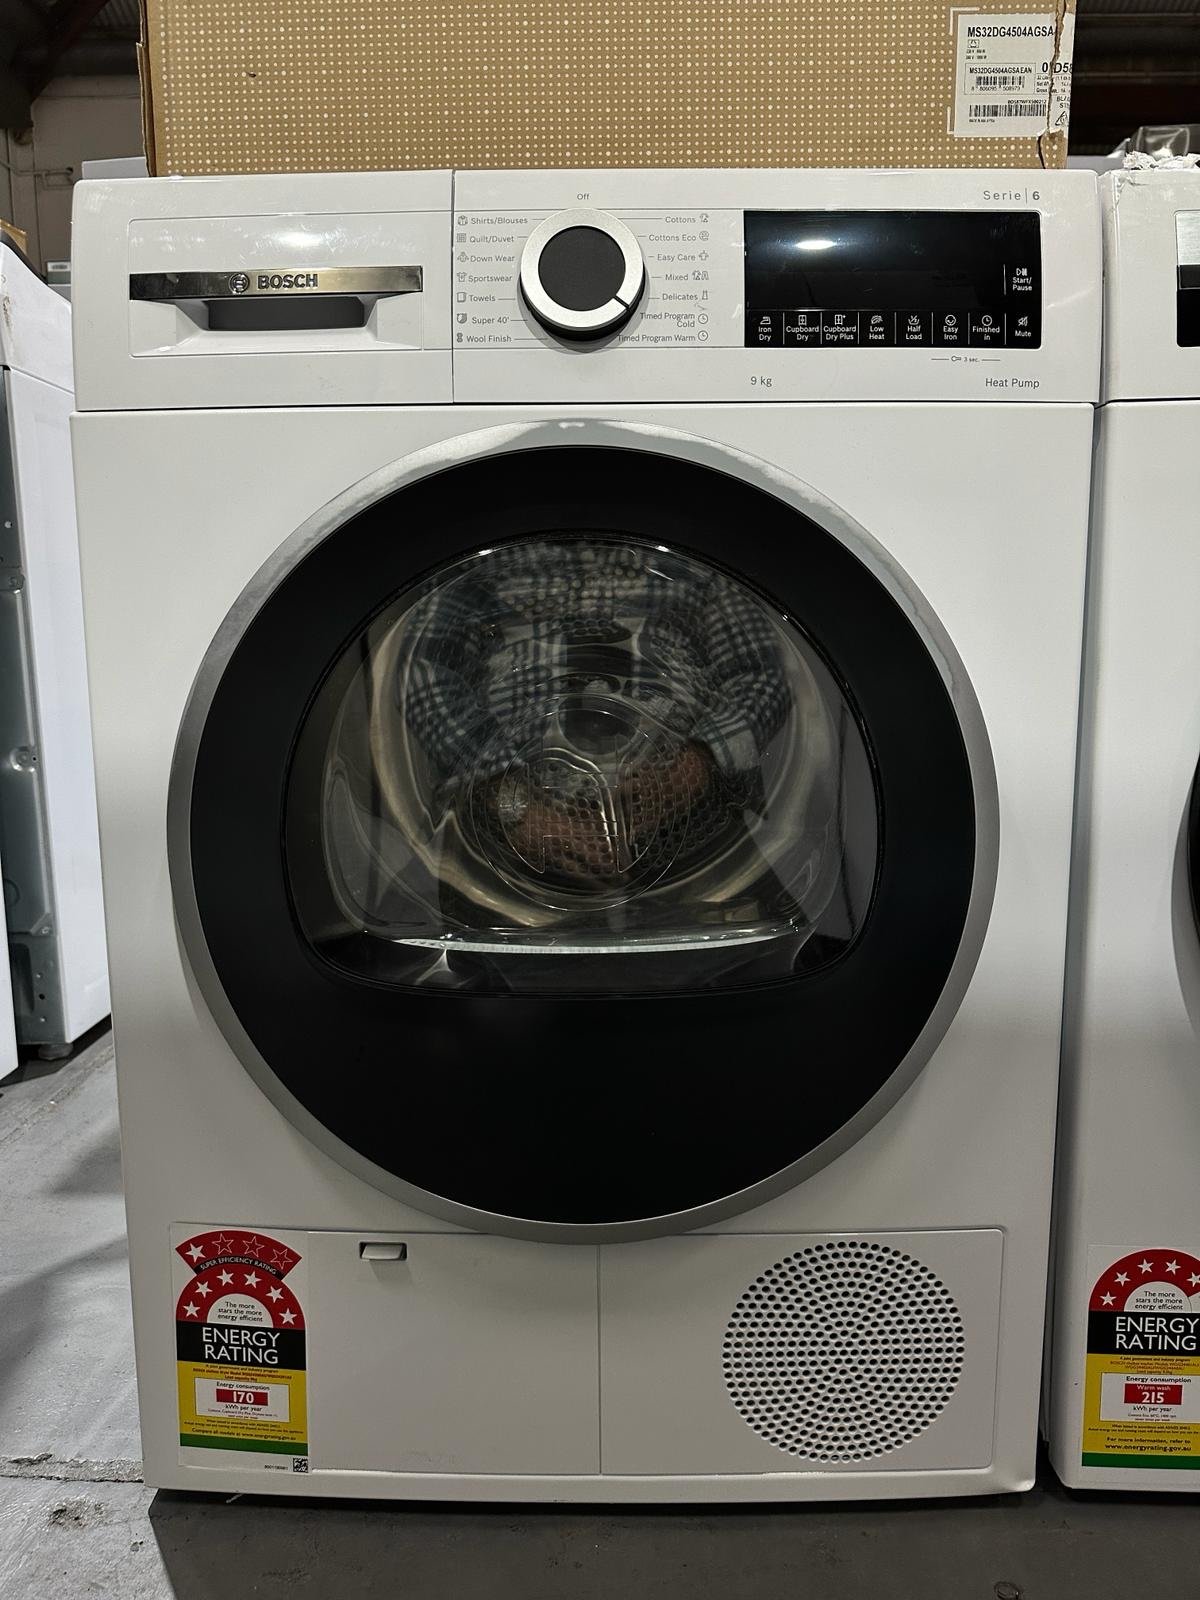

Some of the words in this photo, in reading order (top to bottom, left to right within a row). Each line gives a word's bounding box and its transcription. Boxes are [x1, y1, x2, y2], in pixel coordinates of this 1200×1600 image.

[968, 26, 1054, 37] MS32DG4504AGSA
[983, 190, 1021, 200] Serie
[1032, 191, 1040, 200] 6
[470, 215, 528, 225] Shirts/Blouses
[665, 215, 696, 224] Cottons
[469, 234, 515, 244] Quilt/Duvet
[648, 233, 680, 242] Cottons
[682, 233, 697, 242] Eco
[470, 254, 492, 263] Down
[494, 254, 515, 263] Wear
[657, 253, 675, 263] Easy
[677, 253, 696, 262] Care
[257, 273, 319, 290] BOSCH
[468, 273, 513, 283] Sportswear
[665, 273, 689, 282] Mixed
[1012, 276, 1032, 285] Start/
[1012, 284, 1033, 292] Pause
[468, 293, 496, 302] Towels
[662, 292, 699, 301] Delicates
[471, 316, 494, 326] Super
[640, 312, 662, 321] Timed
[664, 312, 696, 322] Program
[676, 320, 695, 328] Cold
[758, 325, 772, 333] Iron
[786, 325, 819, 334] Cupboard
[823, 325, 857, 334] Cupboard
[870, 325, 885, 333] Low
[907, 325, 921, 333] Half
[943, 325, 959, 335] Easy
[972, 325, 1001, 334] Finished
[466, 334, 486, 343] Wool
[487, 334, 512, 343] Finish
[758, 333, 772, 342] Dry
[796, 333, 809, 342] Dry
[825, 333, 838, 342] Dry
[839, 333, 854, 341] Plus
[869, 333, 885, 341] Heat
[905, 332, 922, 341] Load
[943, 333, 958, 341] Iron
[983, 333, 991, 341] in
[1014, 330, 1032, 338] Mute
[617, 334, 643, 343] Timed
[644, 334, 673, 344] Program
[674, 334, 696, 343] Warm
[750, 376, 758, 386] 9
[760, 376, 773, 388] kg
[985, 378, 1009, 388] Heat
[1011, 378, 1040, 389] Pump
[200, 1259, 218, 1270] SUPER
[218, 1256, 253, 1266] EFFICIENCY
[254, 1261, 276, 1275] RATING
[1115, 1316, 1199, 1334] ENERGY
[202, 1326, 281, 1347] ENERGY
[1115, 1333, 1197, 1351] RATING
[204, 1344, 279, 1364] RATING
[216, 1381, 235, 1389] Energy
[236, 1383, 271, 1391] consumption
[233, 1390, 254, 1404] 170
[1141, 1391, 1165, 1404] 215
[1105, 1443, 1192, 1452] www.energyrating.gov.au
